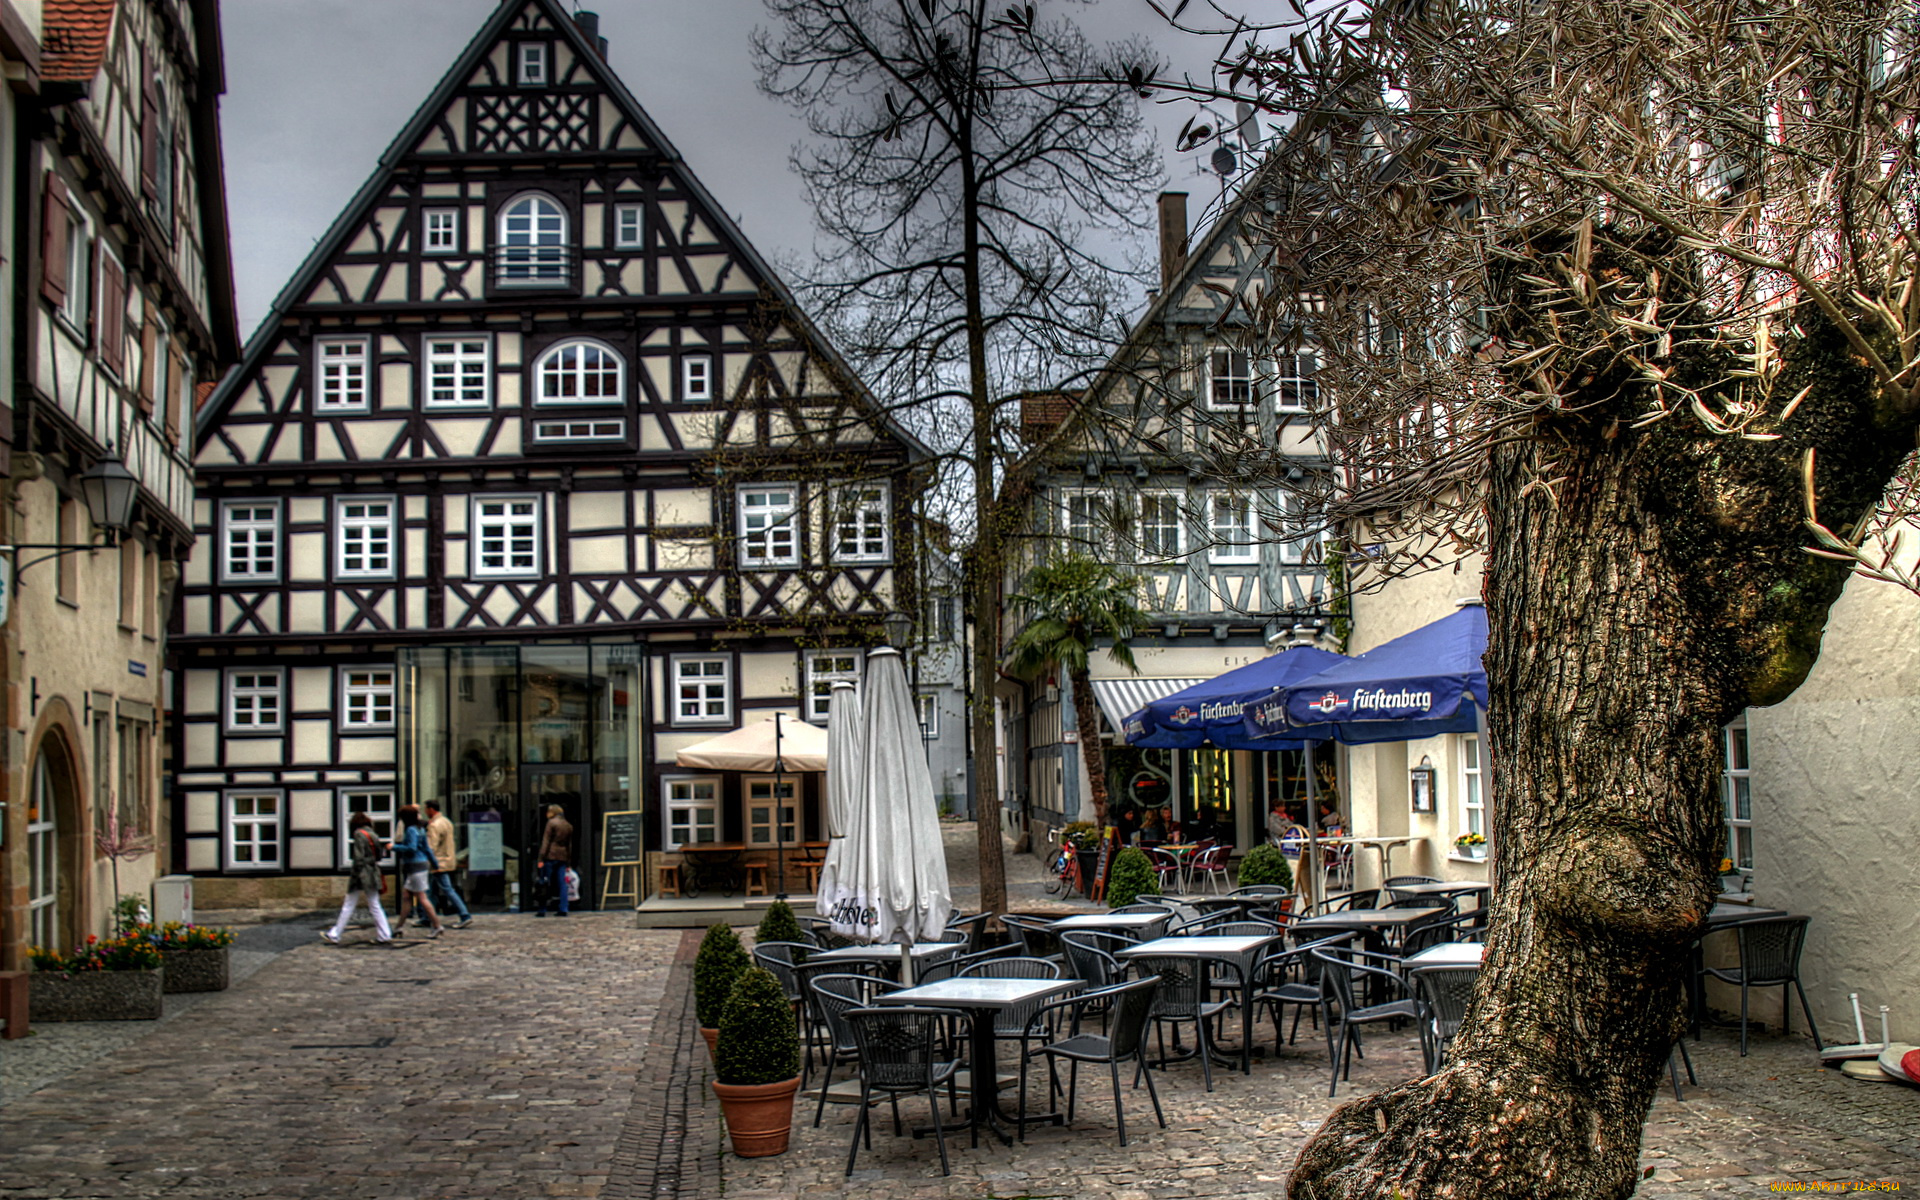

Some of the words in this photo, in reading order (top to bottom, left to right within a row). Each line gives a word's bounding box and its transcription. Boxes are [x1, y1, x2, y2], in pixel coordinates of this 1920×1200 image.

[1224, 656, 1249, 667] EIS
[1200, 699, 1248, 723] Fürstenbe
[1353, 687, 1432, 712] Fürstenberg
[459, 780, 513, 811] pfauen
